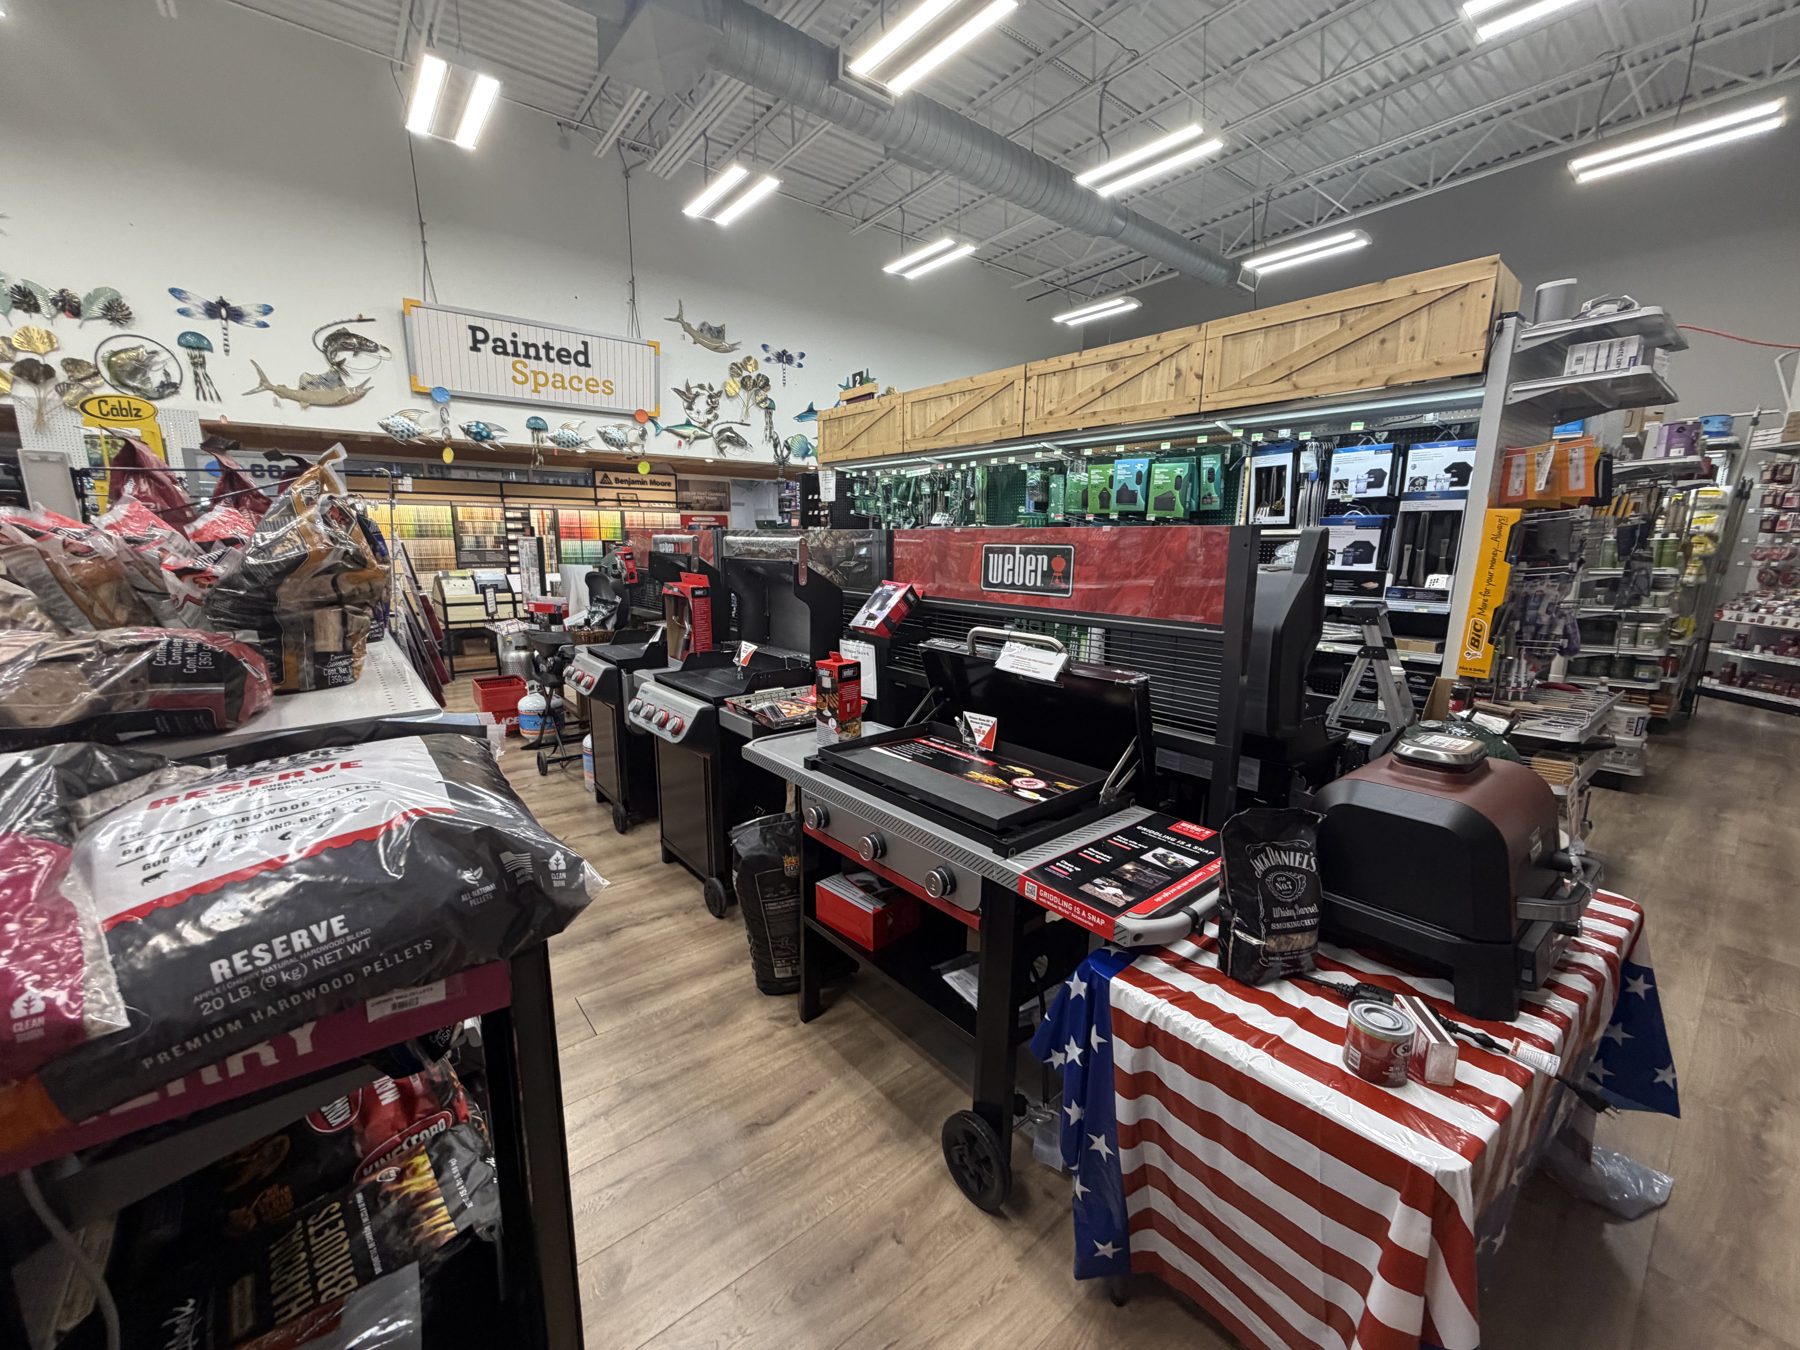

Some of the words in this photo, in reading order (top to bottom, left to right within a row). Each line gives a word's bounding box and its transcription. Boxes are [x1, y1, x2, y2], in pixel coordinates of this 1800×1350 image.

[468, 325, 591, 368] Painted
[511, 360, 614, 396] Spaces
[615, 477, 648, 487] Benjamin
[649, 478, 671, 487] Moore
[988, 546, 1048, 587] weber
[1476, 598, 1488, 617] More
[1485, 570, 1496, 587] your
[1469, 622, 1483, 649] BIC
[147, 759, 364, 810] RESERVE
[1136, 825, 1176, 843] GRIDDLING
[1192, 844, 1216, 856] SNAP
[1250, 852, 1271, 879] JACK
[1265, 846, 1318, 873] DANIEL'S
[1039, 888, 1074, 911] GRIDDLING
[1073, 904, 1082, 914] IS
[1087, 911, 1106, 927] SNAP
[192, 985, 221, 1003] APPLE
[261, 957, 299, 975] NATURAL
[300, 938, 345, 960] HARDWOOD
[346, 927, 372, 943] BLEND
[210, 914, 349, 984] RESERVE
[200, 998, 225, 1016] 20
[230, 986, 257, 1002] LB.
[259, 974, 277, 992] (9
[280, 962, 309, 985] kg)
[312, 948, 343, 971] NET
[347, 936, 372, 956] WT
[142, 1018, 243, 1070] PREMIUM
[250, 973, 355, 1024] HARDWOOD
[361, 938, 434, 978] PELLETS
[306, 1201, 358, 1304] BRIQUETS
